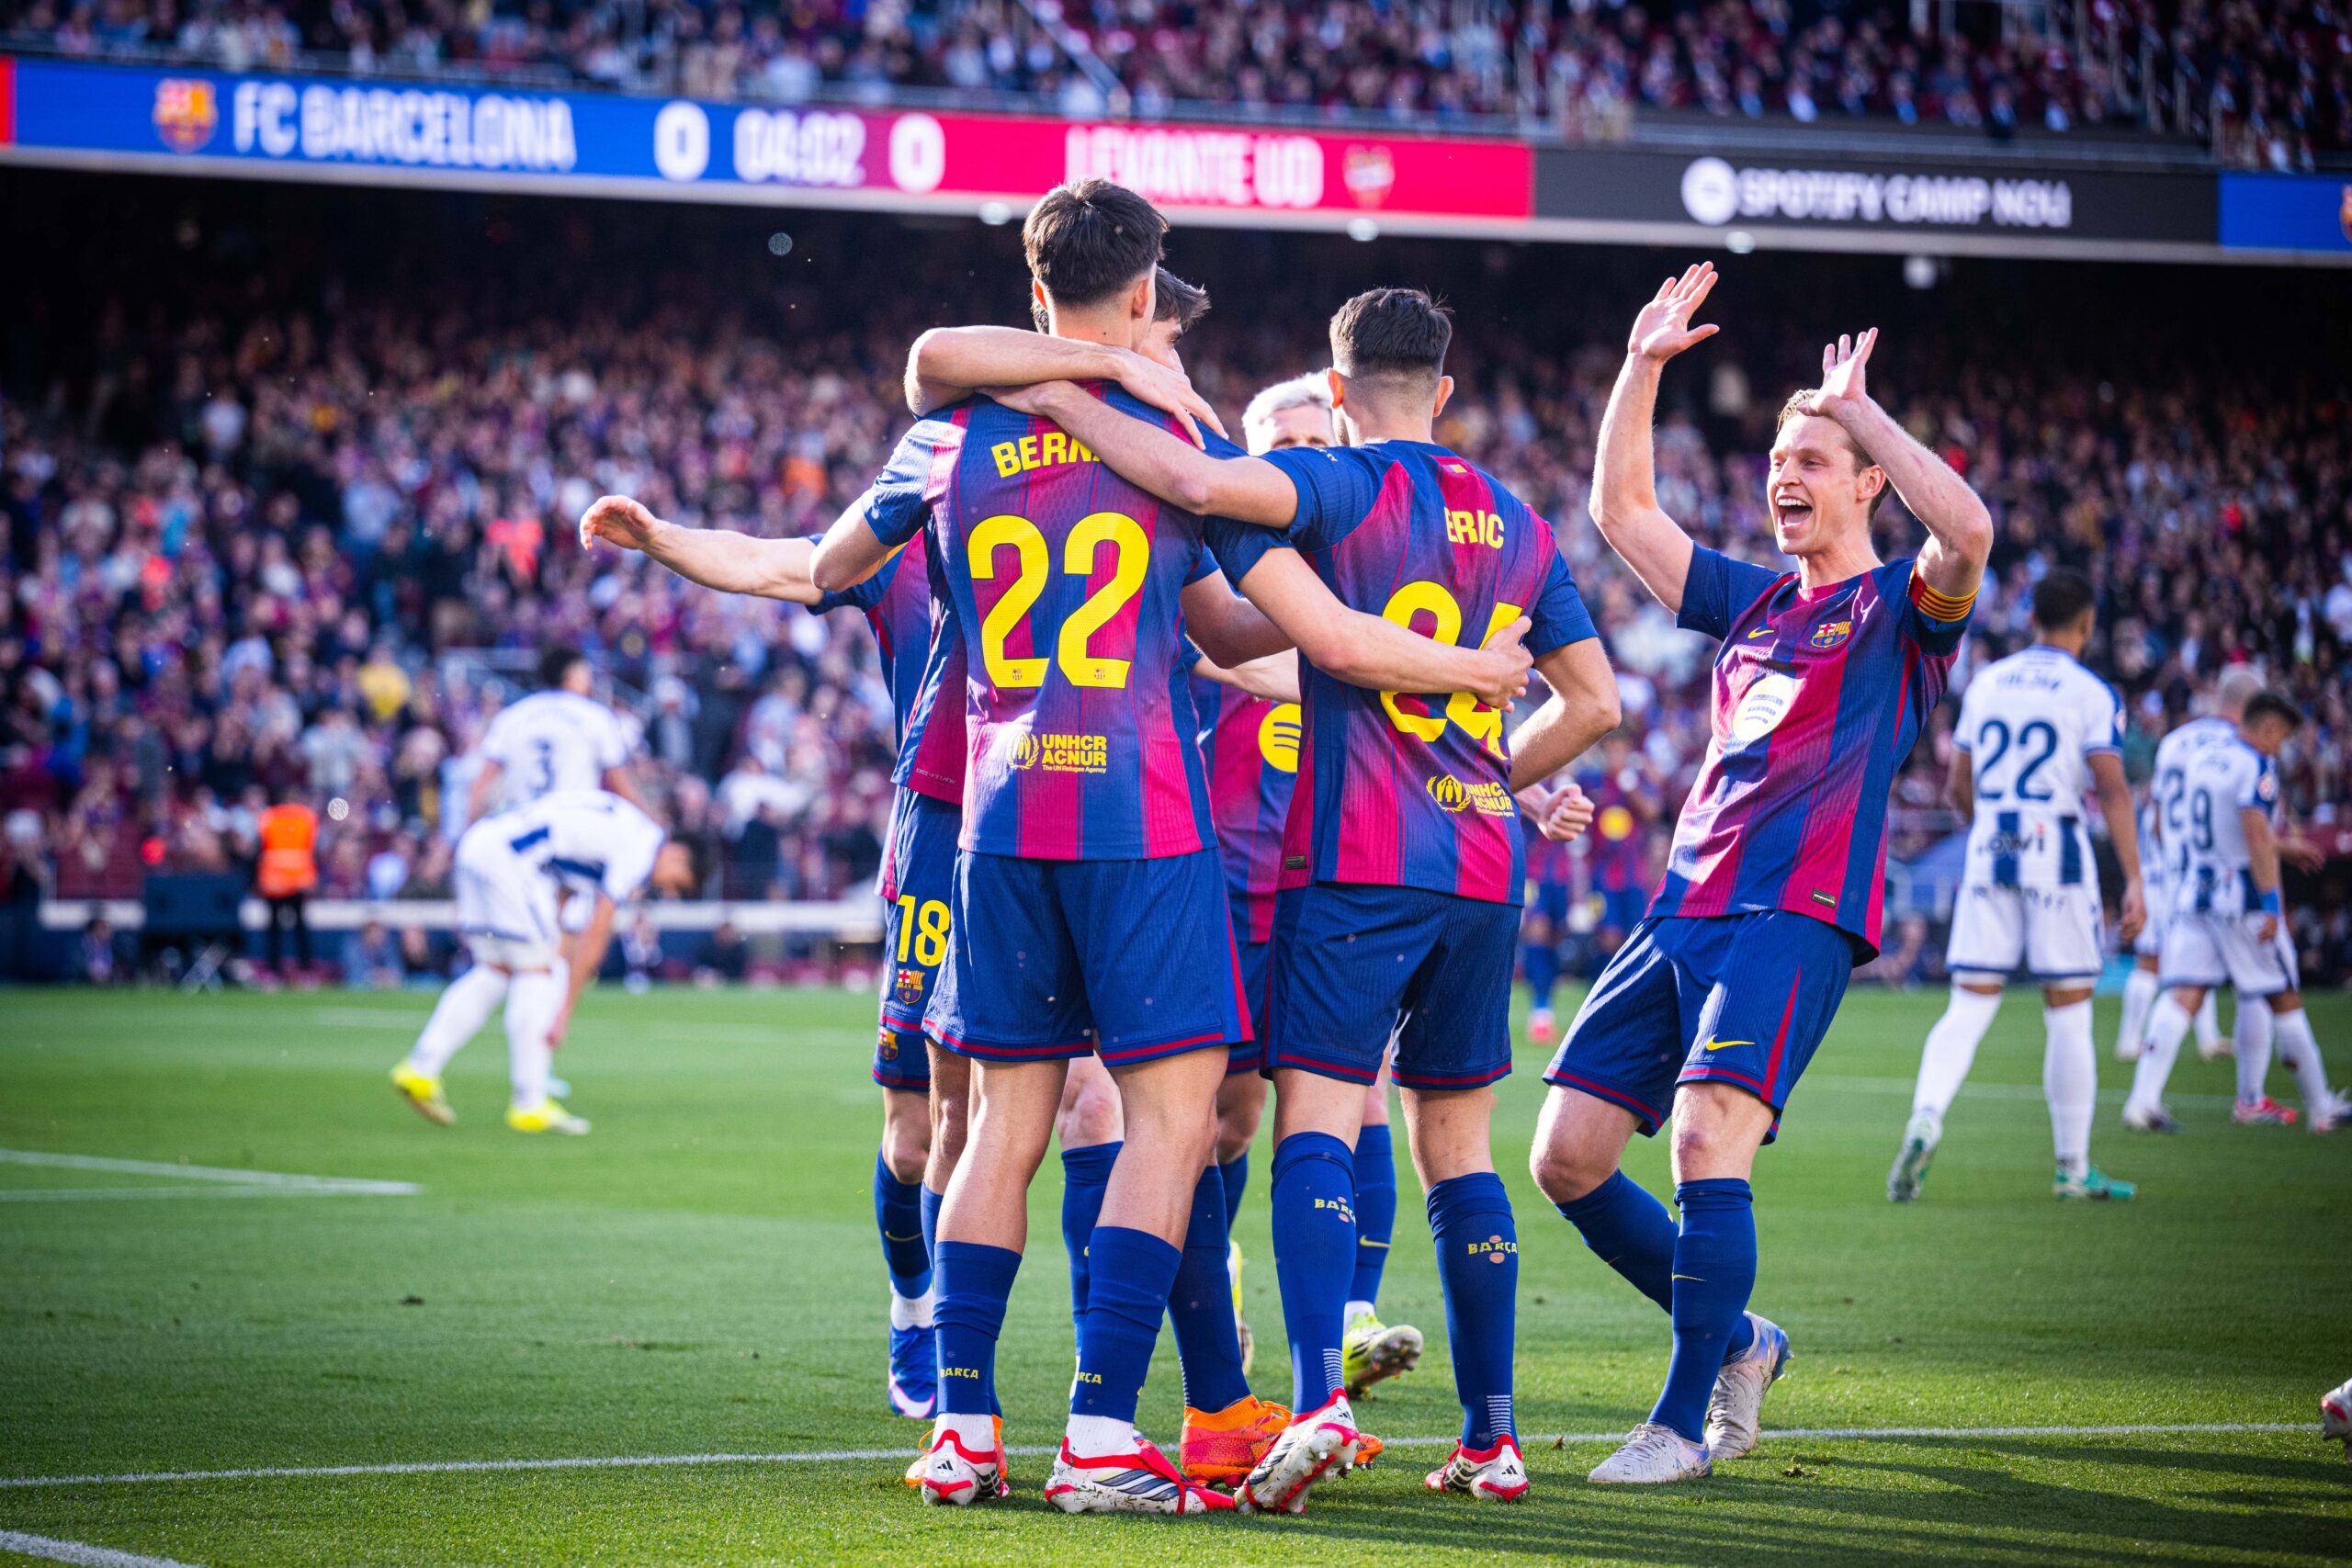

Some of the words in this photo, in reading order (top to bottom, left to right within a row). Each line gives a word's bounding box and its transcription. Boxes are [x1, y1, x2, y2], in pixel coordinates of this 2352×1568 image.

[233, 81, 298, 157] FC
[300, 85, 578, 173] BARCELONA
[653, 101, 710, 182] 0
[888, 112, 945, 193] 0
[1736, 167, 1883, 221] SPOTIFY
[1884, 174, 1992, 225] CAMP
[991, 432, 1100, 478] BERN
[1443, 506, 1505, 549] ERIC
[967, 511, 1149, 689] 22
[1042, 734, 1107, 750] UNHCR
[1042, 750, 1107, 766] ACNUR
[1977, 719, 2057, 801] 22
[1473, 795, 1513, 811] ACNUR
[2162, 766, 2212, 851] 29
[897, 894, 951, 967] 18
[1468, 1241, 1518, 1255] BARÇA
[940, 1367, 979, 1380] BARÇA
